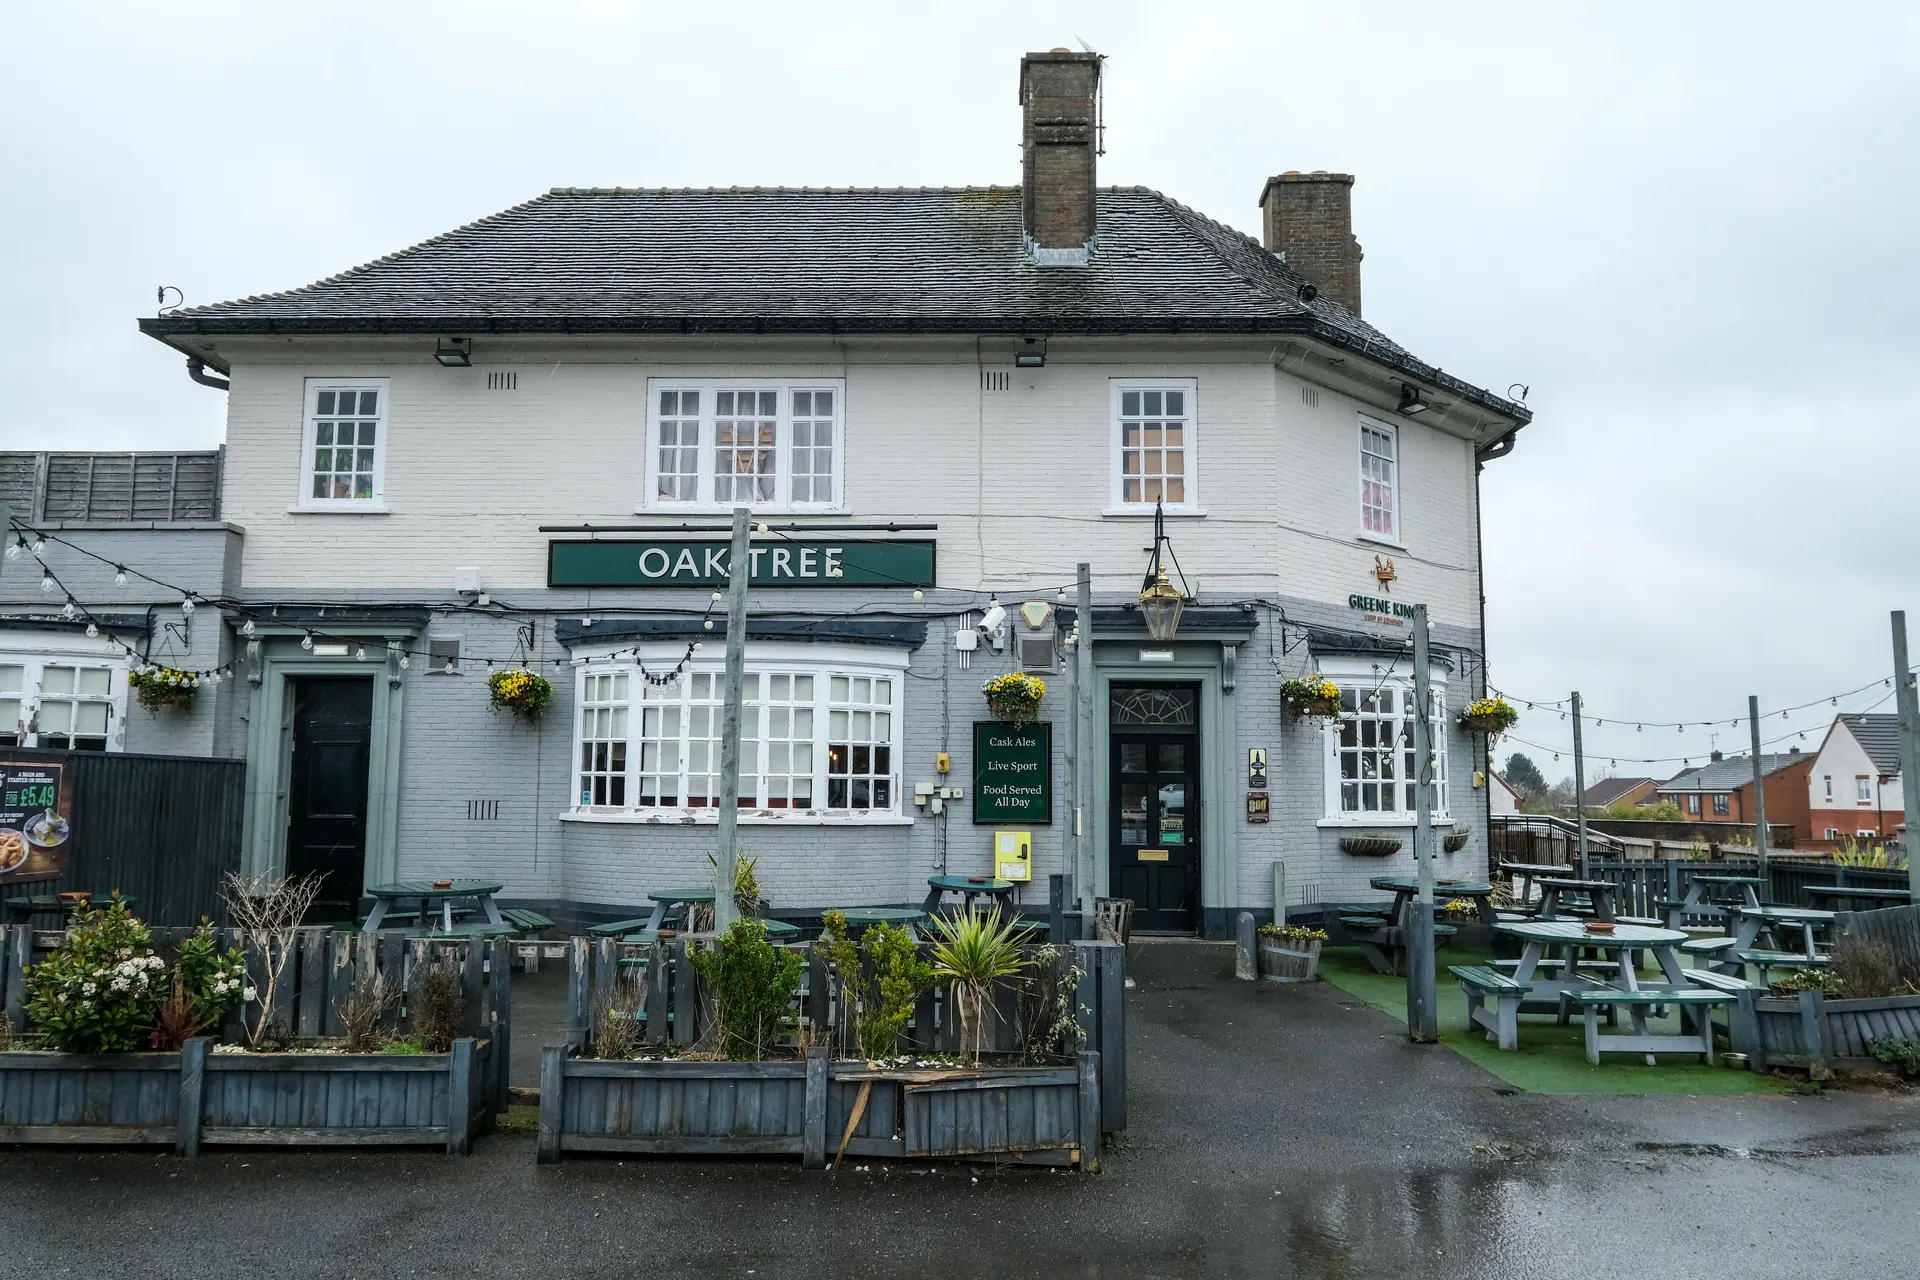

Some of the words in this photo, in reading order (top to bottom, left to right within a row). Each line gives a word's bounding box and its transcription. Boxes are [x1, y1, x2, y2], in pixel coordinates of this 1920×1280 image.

[638, 547, 730, 578] OAK
[749, 547, 844, 578] TREE
[1349, 594, 1391, 614] GREENE
[989, 736, 1013, 747] Cask
[1015, 736, 1036, 747] Ales
[988, 760, 1009, 771] Live
[1010, 761, 1038, 773] Sport
[6, 794, 18, 804] FOR
[20, 786, 54, 806] £5.49
[983, 784, 1007, 795] Food
[1009, 784, 1042, 795] Served
[994, 796, 1009, 807] All
[1010, 797, 1031, 809] Day
